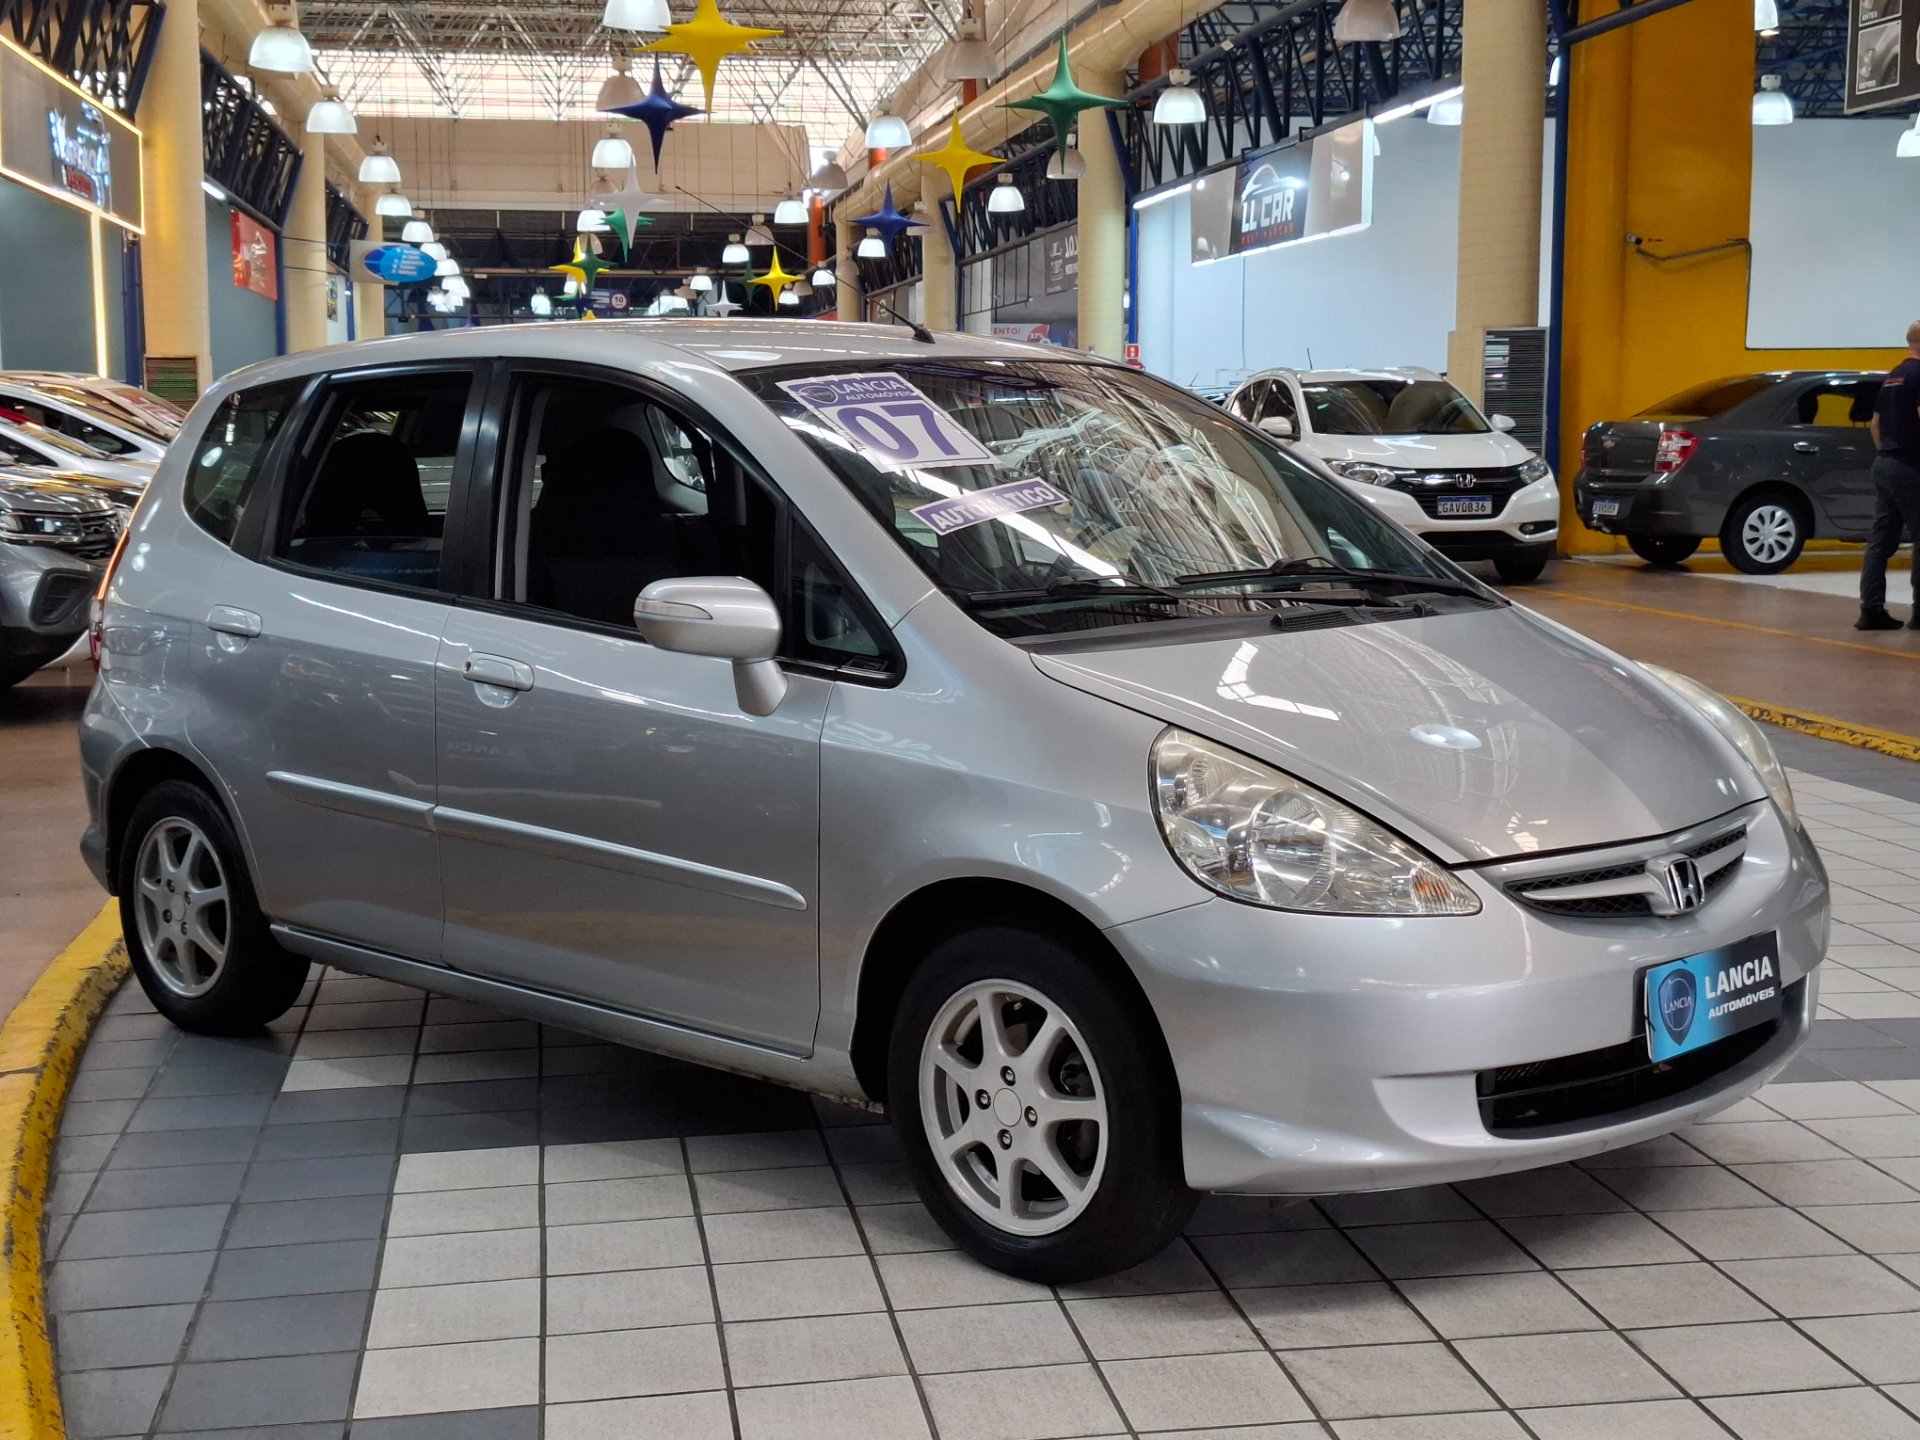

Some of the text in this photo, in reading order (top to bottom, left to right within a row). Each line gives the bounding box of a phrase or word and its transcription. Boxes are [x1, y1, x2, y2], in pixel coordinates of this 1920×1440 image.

[1261, 188, 1295, 228] CAR
[831, 380, 907, 394] LANCIA
[836, 403, 960, 460] 07
[930, 486, 1055, 530] AUTOMÁTICO
[1705, 956, 1773, 999] LANCIA
[1664, 996, 1693, 1014] LANCIA
[1708, 986, 1775, 1019] AUTOMÓVEIS
